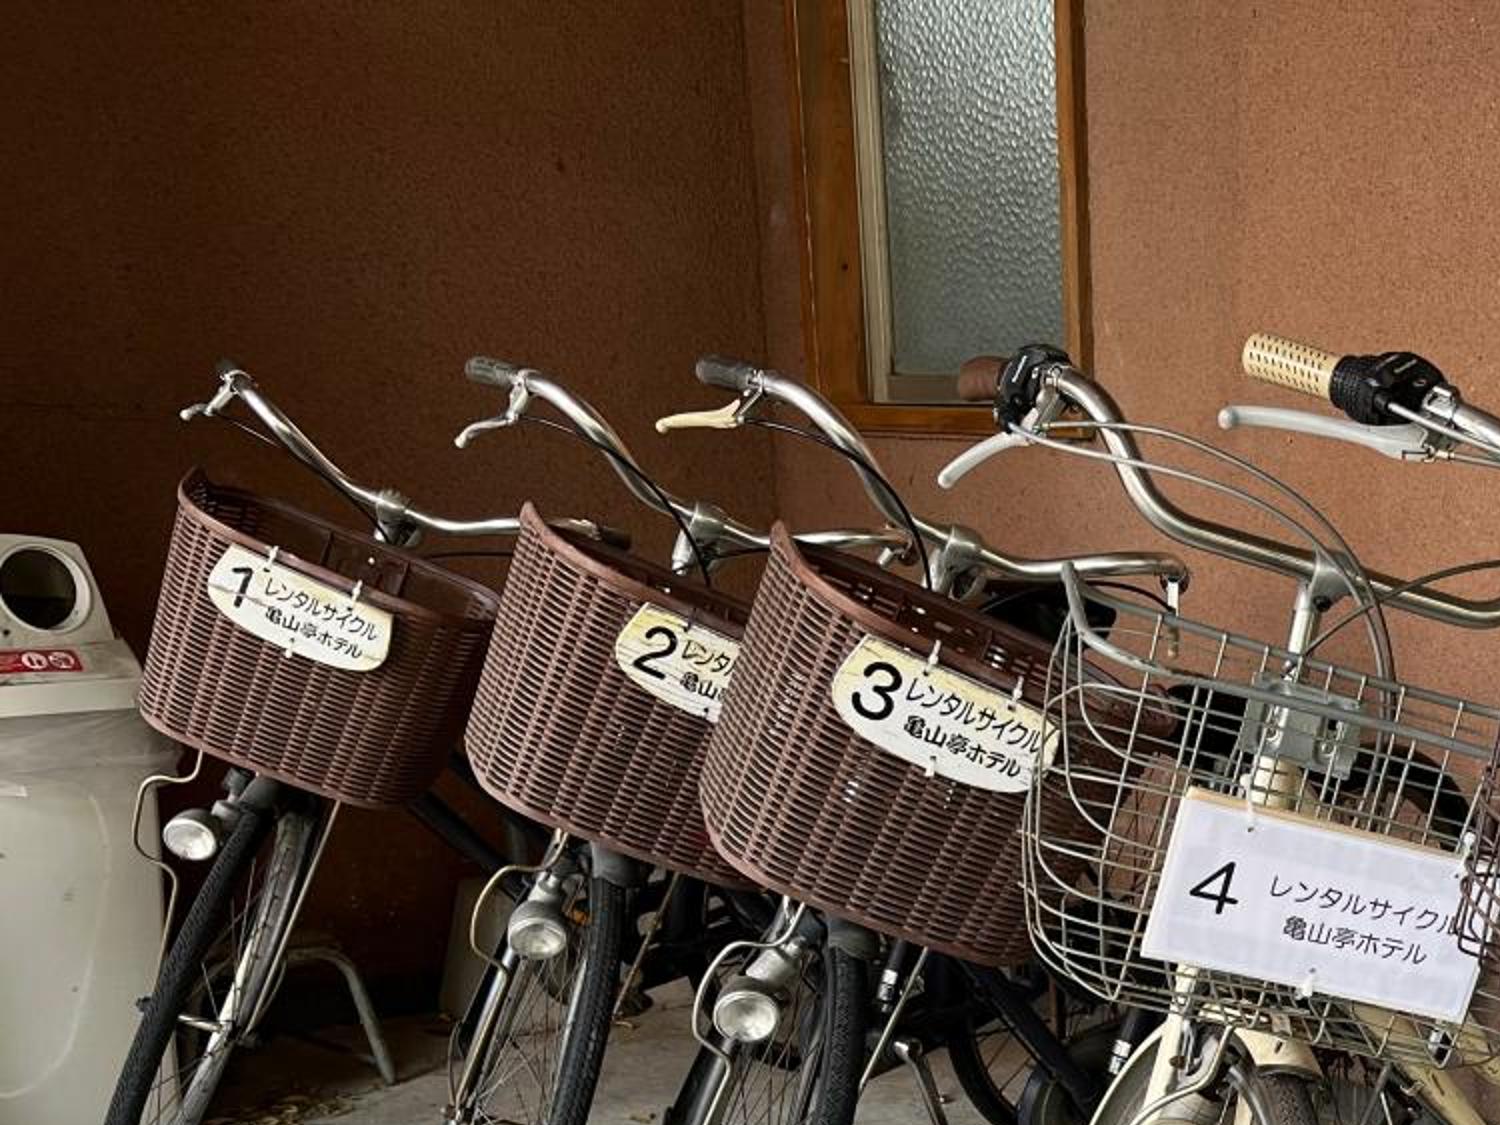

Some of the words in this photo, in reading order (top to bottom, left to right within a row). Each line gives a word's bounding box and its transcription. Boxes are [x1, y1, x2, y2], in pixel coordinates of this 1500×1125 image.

[232, 566, 254, 608] 1
[265, 577, 377, 641] レンタルサイクル
[265, 605, 363, 659] 亀山亭ホテル
[633, 625, 678, 680] 2
[680, 671, 722, 701] 亀山
[851, 661, 903, 721] 3
[905, 677, 1041, 754] レンタルサイクル
[903, 714, 1022, 778] 亀山亭ホテル
[1189, 860, 1239, 916] 4
[1269, 874, 1461, 936] レンタルサイクル
[1282, 914, 1428, 965] 亀山亭ホテル
